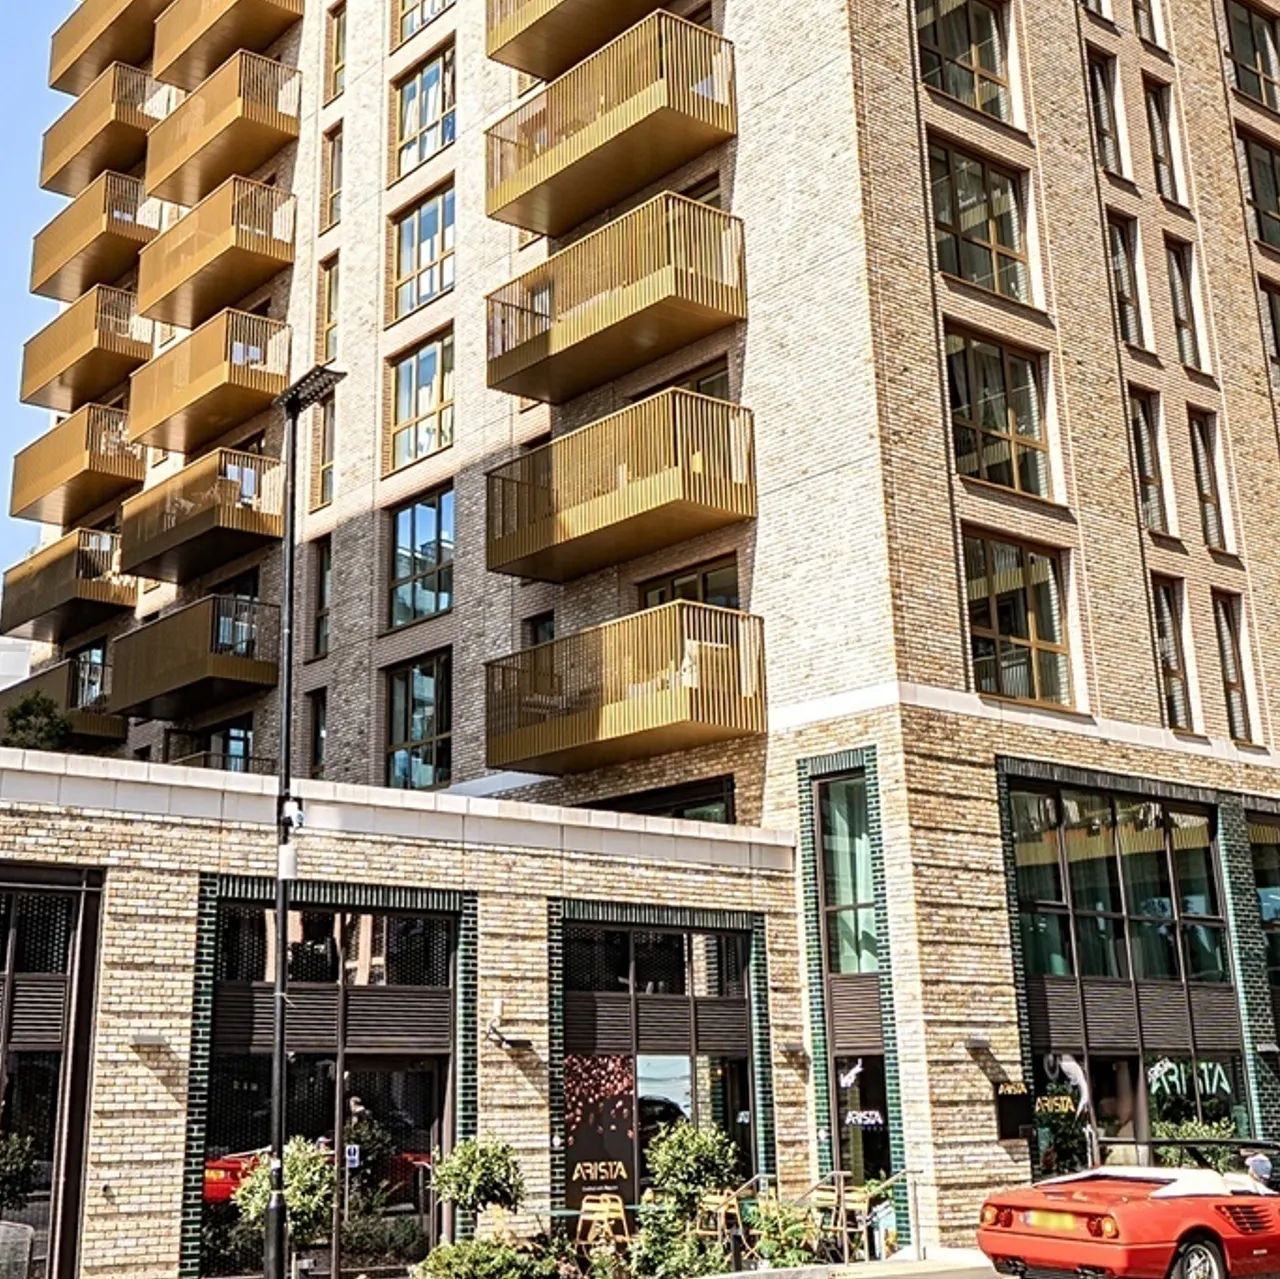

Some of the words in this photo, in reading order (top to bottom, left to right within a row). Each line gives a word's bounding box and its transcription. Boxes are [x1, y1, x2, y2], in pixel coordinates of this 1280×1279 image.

[1150, 1062, 1231, 1095] ARITA
[1035, 1095, 1076, 1112] ARISTA
[845, 1110, 884, 1125] ARISTA
[572, 1160, 629, 1181] ARISTA
